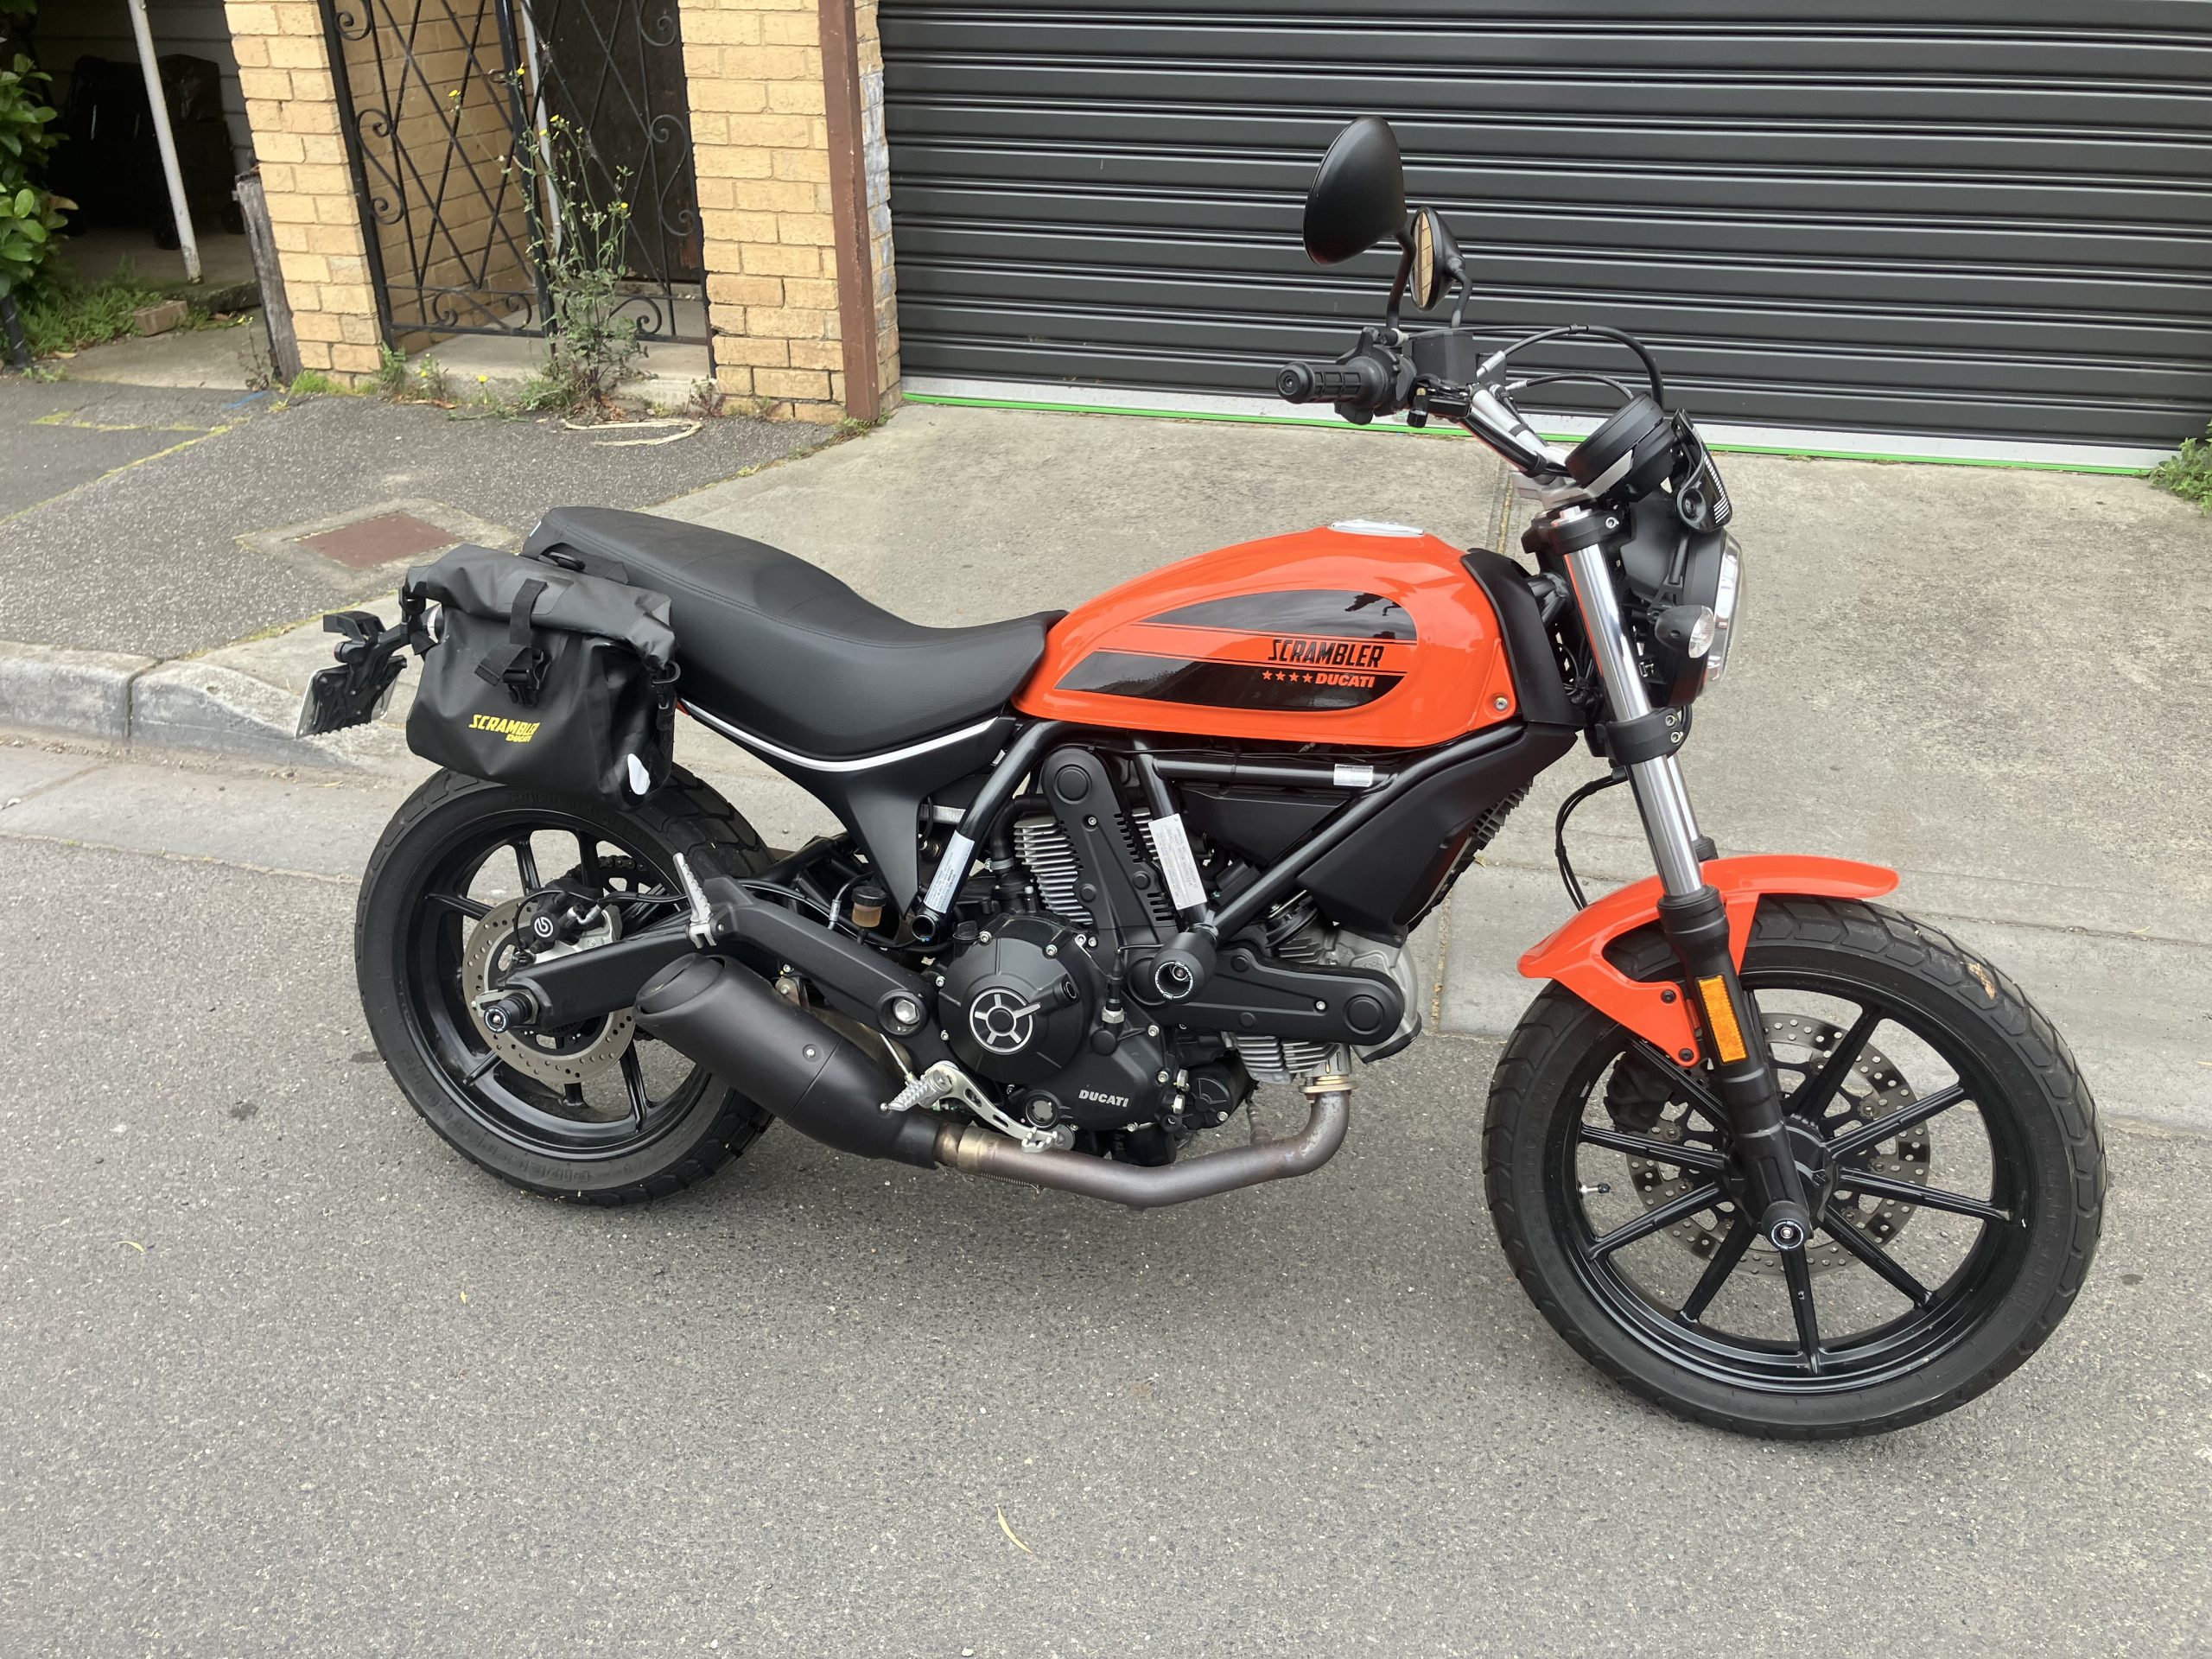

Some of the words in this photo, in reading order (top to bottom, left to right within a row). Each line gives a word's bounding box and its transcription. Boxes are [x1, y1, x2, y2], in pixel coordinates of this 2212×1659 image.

[1268, 639, 1384, 668] SCRAMBLER
[1315, 672, 1376, 688] DUCATI
[468, 714, 540, 734] SCRAMBLE
[1078, 1089, 1128, 1108] DUCATI
